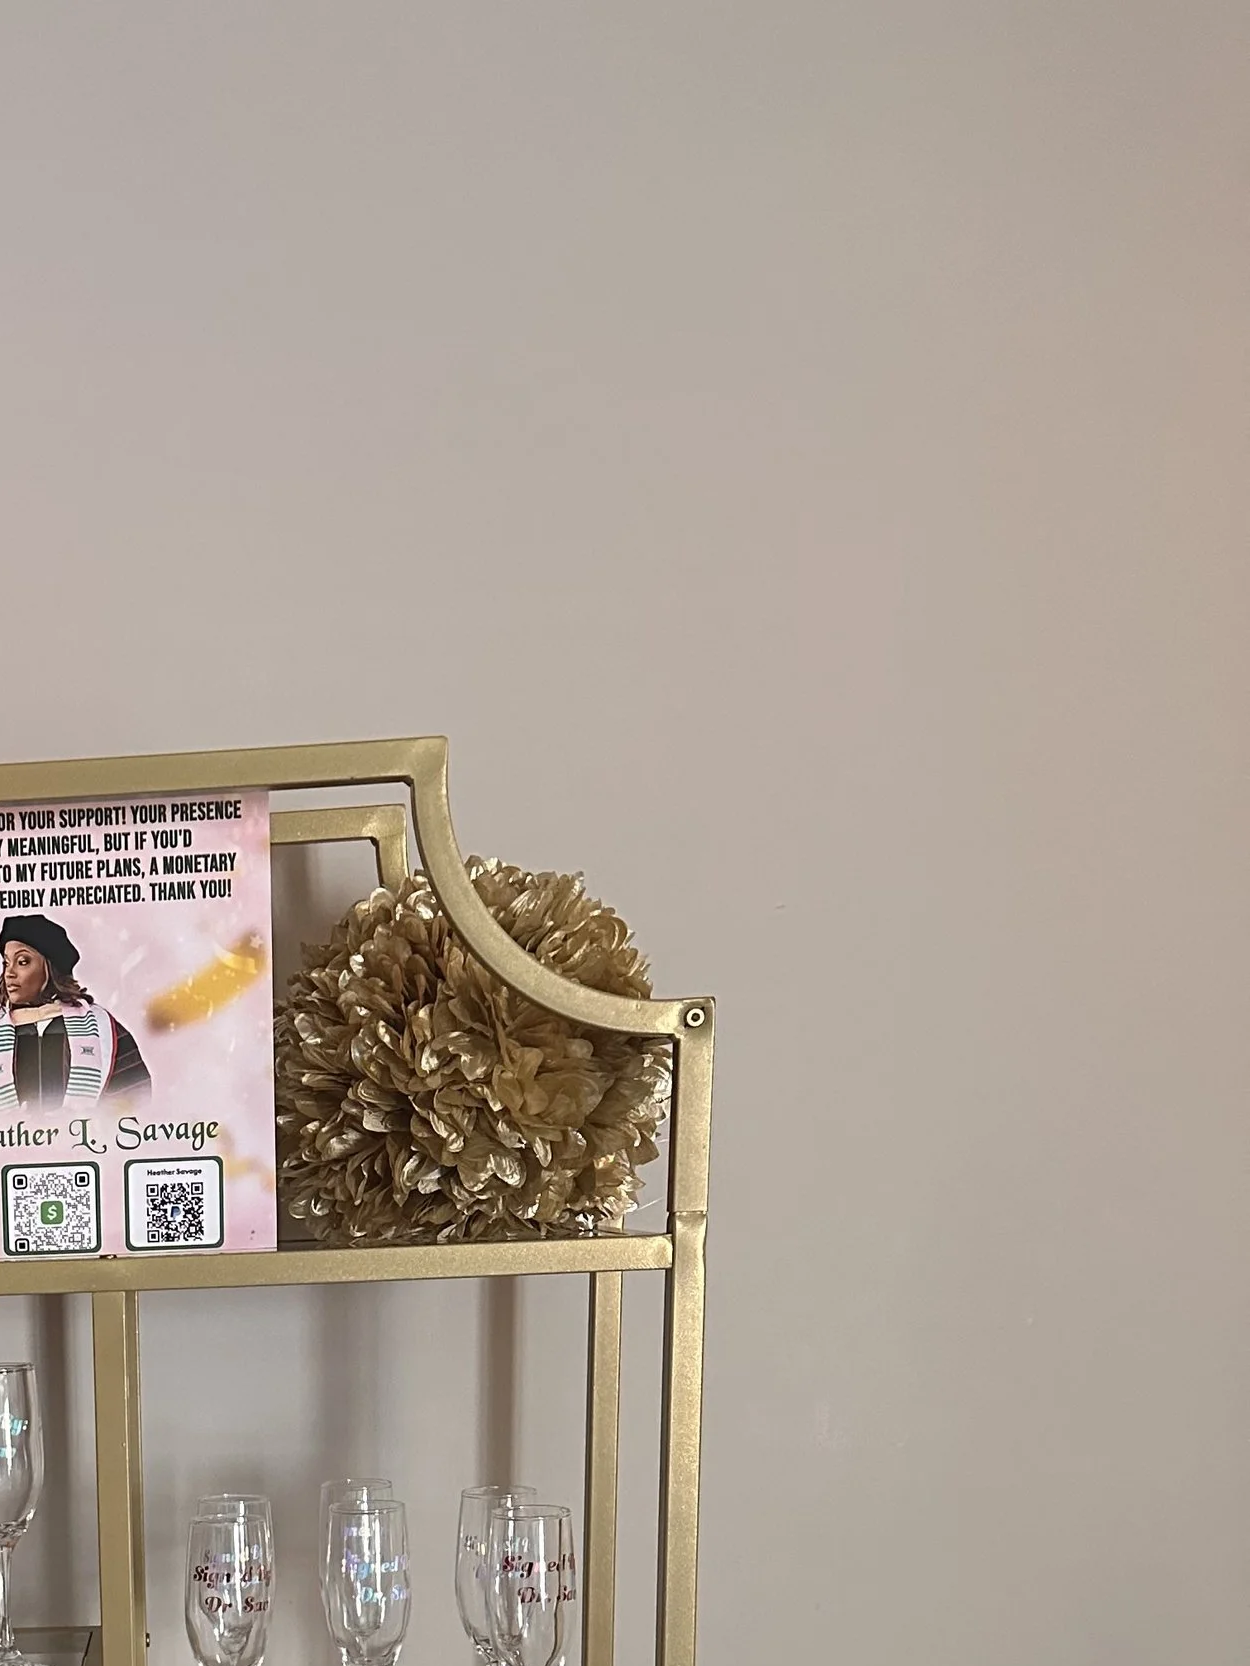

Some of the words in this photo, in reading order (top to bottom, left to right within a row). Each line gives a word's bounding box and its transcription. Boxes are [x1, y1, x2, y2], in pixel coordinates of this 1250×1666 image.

[19, 810, 55, 830] YOUR
[59, 806, 126, 828] SUPPORT!
[130, 804, 167, 824] YOUR
[171, 800, 242, 822] PRESENCE
[7, 834, 99, 857] MEANINGFUL,
[104, 832, 130, 851] BUT
[134, 831, 147, 850] IF
[151, 829, 192, 849] YOU'D
[15, 863, 36, 882] MY
[41, 860, 92, 881] FUTURE
[96, 858, 145, 879] PLANS,
[149, 857, 158, 875] A
[163, 853, 236, 875] MONETARY
[49, 884, 145, 907] APPRECIATED.
[149, 881, 195, 901] THANK
[200, 879, 232, 898] YOU!
[115, 1117, 219, 1151] Savage
[193, 1565, 253, 1589] Signd
